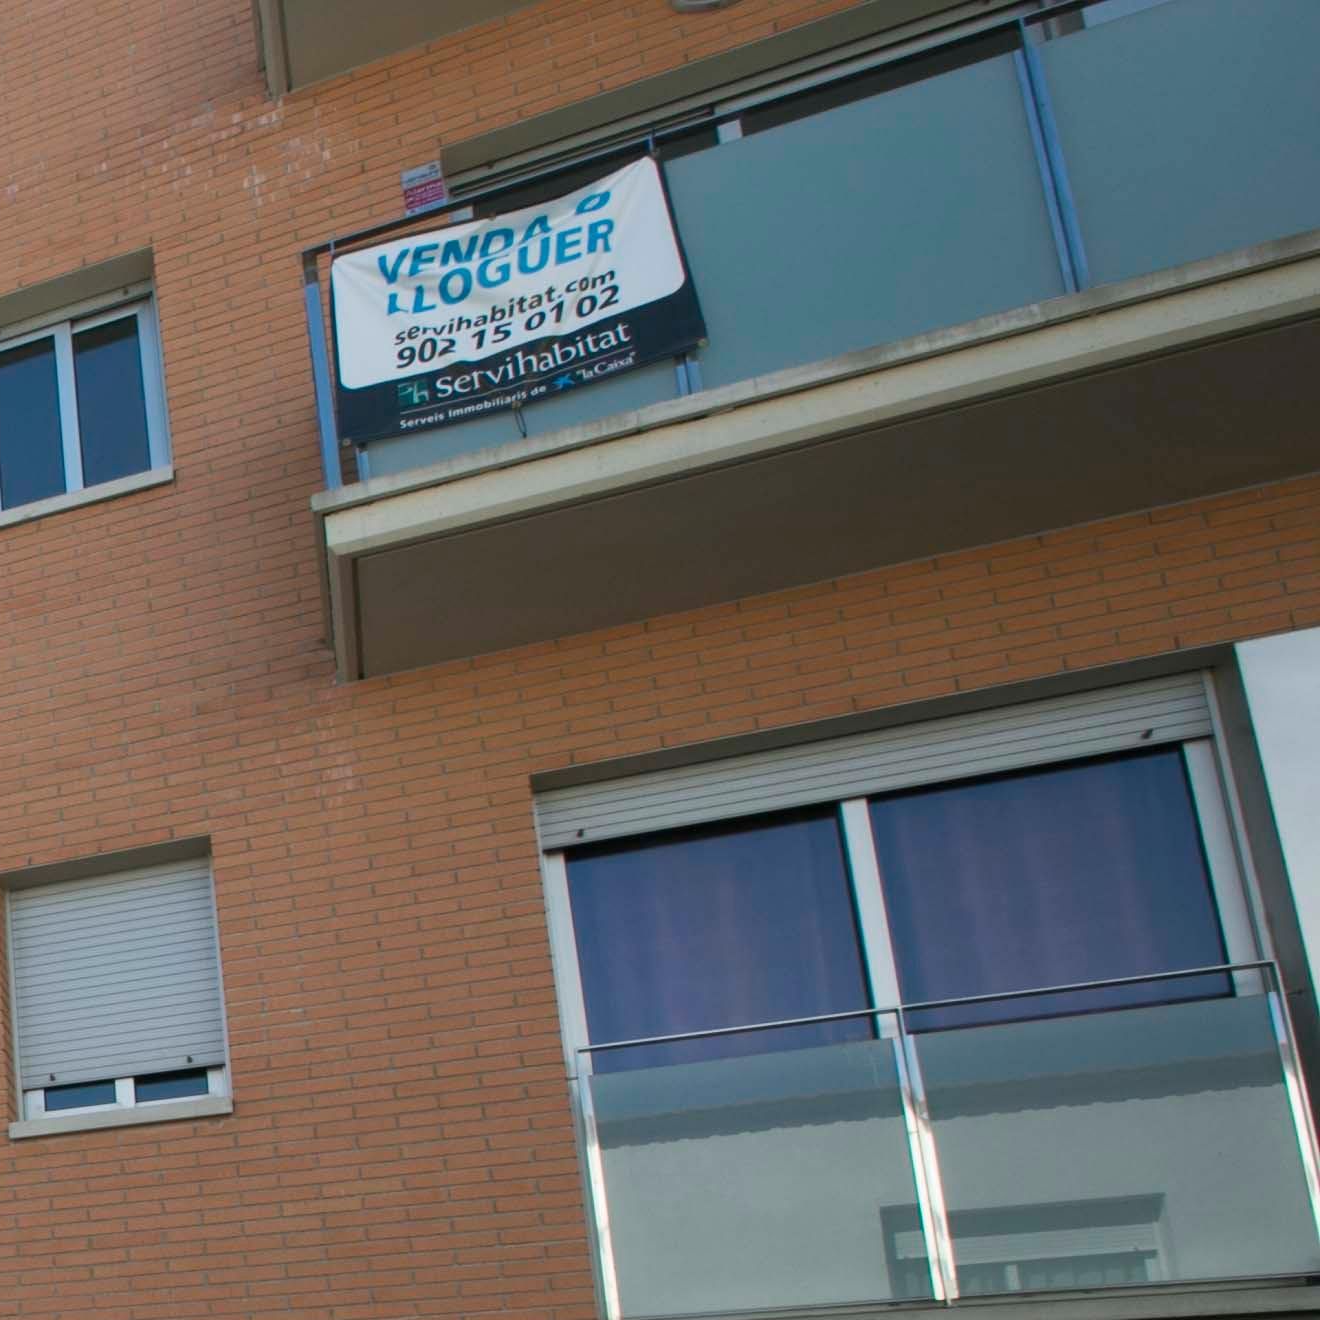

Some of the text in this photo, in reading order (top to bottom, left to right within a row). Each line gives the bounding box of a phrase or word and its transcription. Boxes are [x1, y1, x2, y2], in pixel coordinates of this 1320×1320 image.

[377, 190, 612, 285] VENDA O
[386, 218, 615, 316] LLOGUER
[394, 269, 616, 346] servihabitat.com
[396, 285, 620, 370] 902 15 01 02
[435, 323, 632, 398] Servihabitat
[399, 412, 446, 430] Serveis
[448, 391, 528, 419] Immobiliaris
[530, 384, 548, 397] de
